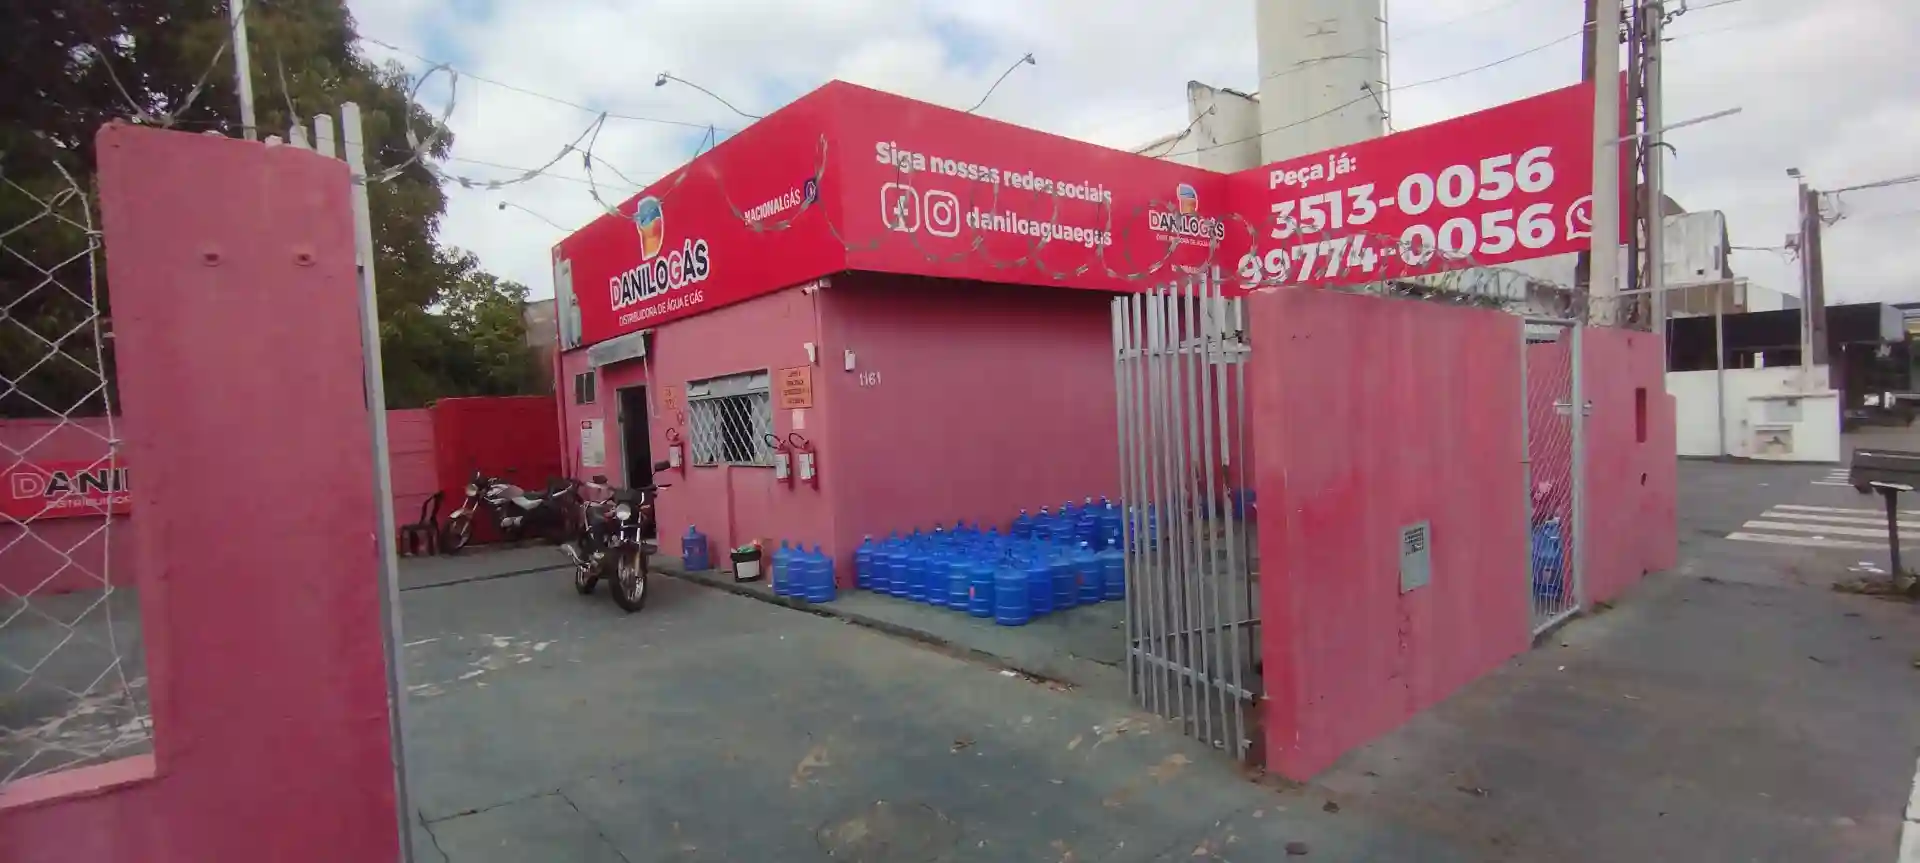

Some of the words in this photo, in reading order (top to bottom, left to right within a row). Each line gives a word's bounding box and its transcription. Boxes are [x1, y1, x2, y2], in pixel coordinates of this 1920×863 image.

[876, 141, 926, 173] Siga
[930, 155, 1000, 185] nossas
[1003, 169, 1054, 195] redes
[1056, 180, 1112, 205] sociais
[1270, 165, 1323, 190] Peça
[1326, 152, 1357, 183] já:
[744, 187, 801, 225] NACIONALGÁS
[1270, 146, 1555, 239] 3513-0056
[965, 207, 1112, 248] daniloaguaegas
[1148, 209, 1225, 241] DANLOGÁS
[1238, 203, 1557, 289] 99774-0056
[609, 239, 710, 311] DANILOGÁS
[619, 305, 658, 326] DISTRIBUIDORA
[689, 289, 704, 305] GÁS
[859, 371, 882, 387] 1161
